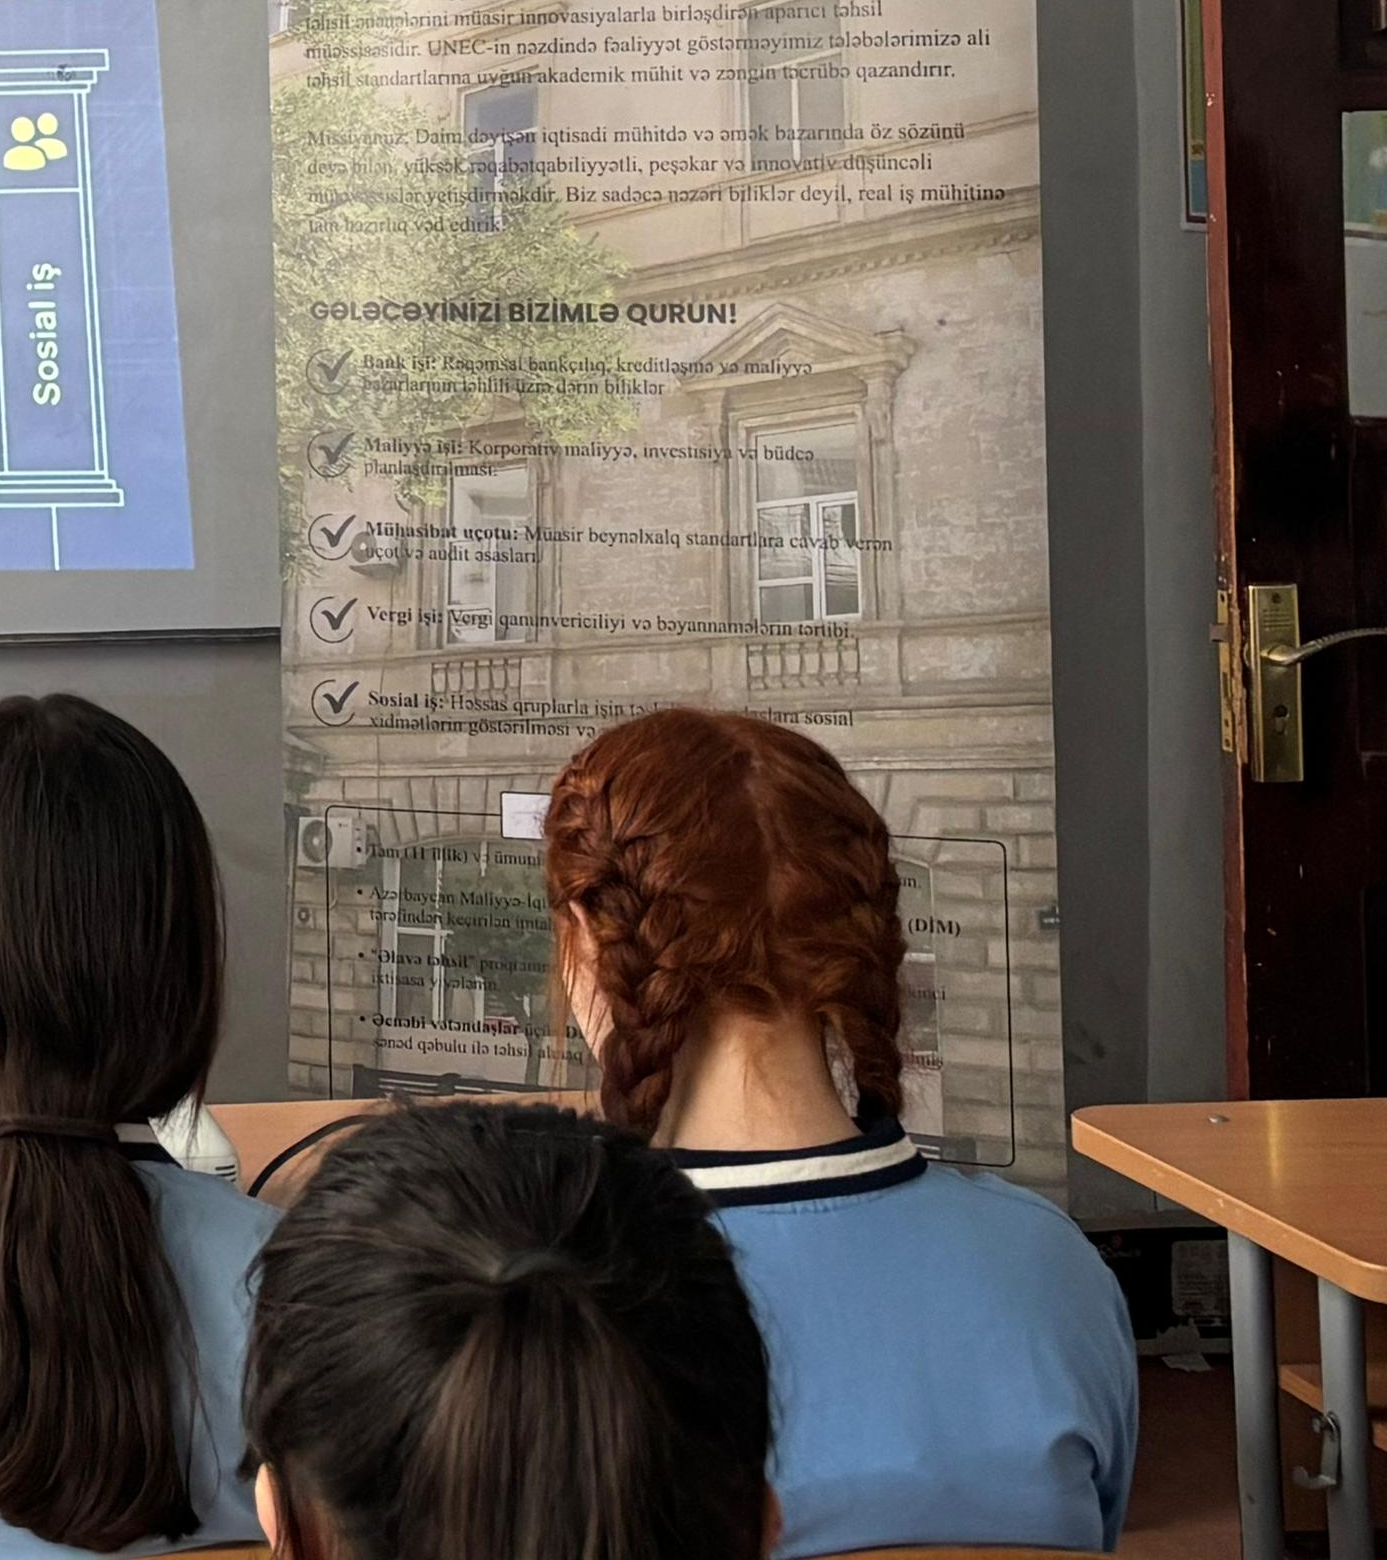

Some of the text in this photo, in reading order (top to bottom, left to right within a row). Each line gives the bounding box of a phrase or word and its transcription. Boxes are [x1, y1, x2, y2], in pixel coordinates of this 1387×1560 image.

[306, 13, 349, 31] təhsil
[454, 10, 513, 26] müasir
[521, 7, 655, 27] innovasiyalarla
[662, 4, 758, 23] birləşdirən
[765, 4, 826, 23] aparıcı
[834, 0, 882, 18] təhsil
[428, 28, 990, 56] UNEC-in nəzdində fəaliyyət göstərməyimiz tələbələrimizə ali
[306, 60, 956, 89] təhsil standartlarına akademik mühit və zəngin təcrübə qazandırır.
[416, 122, 965, 148] Daim dəyişən iqtisadi mühitdə və əmək bazarında öz sözünü
[404, 158, 465, 177] yüksək
[649, 156, 718, 176] peşəkar
[724, 158, 745, 172] və
[842, 152, 932, 174] düşüncəli
[566, 186, 596, 202] Biz
[602, 185, 662, 204] sadəcə
[669, 185, 723, 202] nəzəri
[729, 184, 793, 202] biliklər
[800, 183, 852, 205] deyil,
[858, 183, 892, 201] real
[900, 184, 914, 204] iş
[920, 181, 1006, 201] mühitinə
[414, 217, 444, 232] vəd
[310, 297, 738, 325] GƏLƏCƏYİNİZİ BİZİMLƏ QURUN!
[26, 262, 63, 407] Sosial iş
[363, 354, 405, 370] Bank
[411, 355, 436, 373] işi:
[616, 358, 713, 377] kreditləşmə
[744, 359, 813, 378] maliyyə
[604, 379, 665, 397] biliklər
[364, 437, 814, 462] Maliyyə işi: Korporativ maliyyə, investisiya və büdcə
[365, 521, 893, 552] Mühasibat uçotu: Müasir beynəlxalq standartlara cavab verən
[365, 545, 469, 562] uçot və audit
[367, 606, 855, 639] Vergi işi: Vergi qanunvericiliyi və bəyannamələrin tərtibi.
[368, 690, 418, 708] Sosial
[424, 693, 444, 711] iş:
[450, 694, 508, 711] Həssas
[513, 696, 588, 717] qruplarla
[594, 700, 626, 718] işin
[804, 709, 853, 727] sosial
[368, 715, 595, 737] xidmətlərin göstərilməsi və
[369, 887, 455, 906] Azərbaycan
[908, 917, 961, 937] (DİM)
[372, 1013, 520, 1038] Əcnəbi vətəndaşlar
[417, 1040, 467, 1055] qəbulu
[494, 1042, 532, 1058] təhsil
